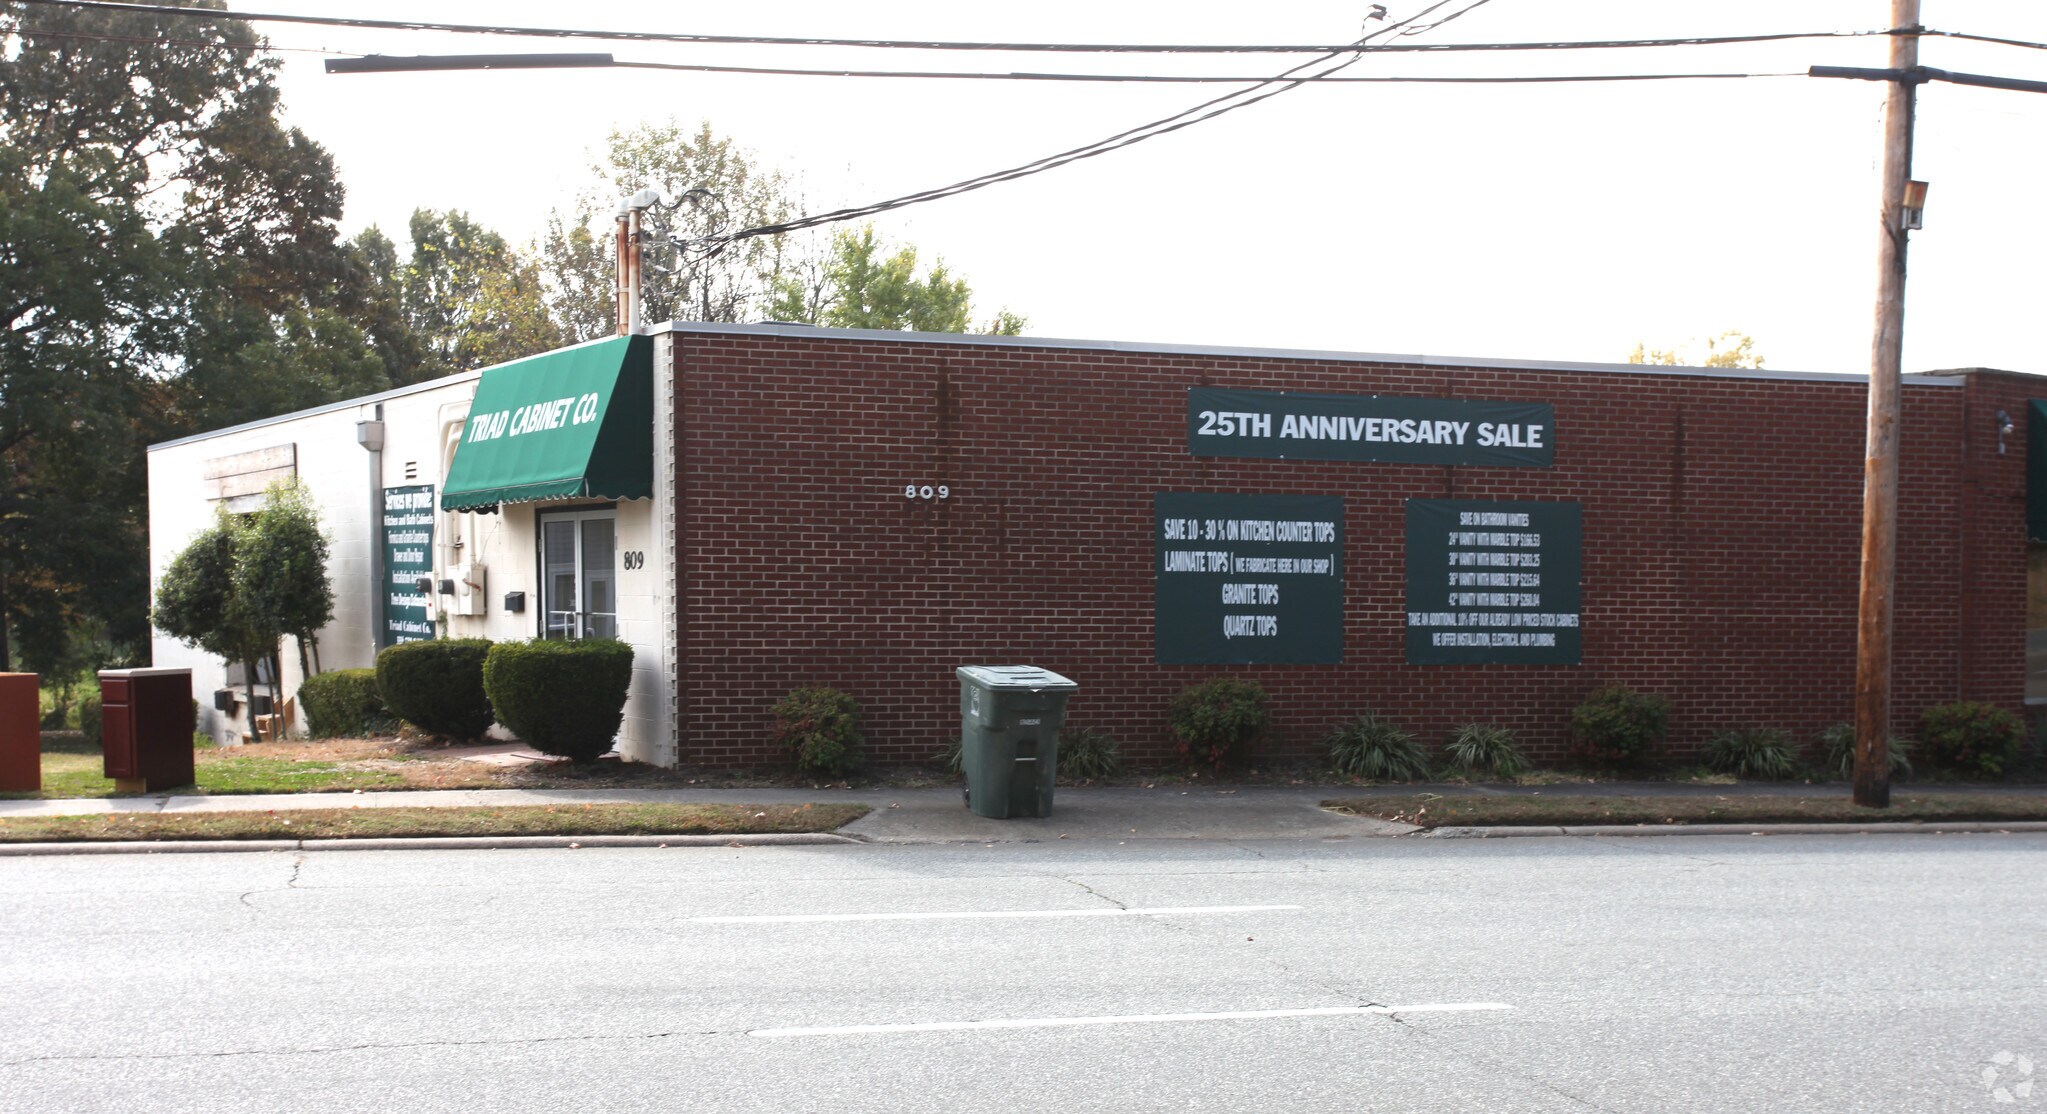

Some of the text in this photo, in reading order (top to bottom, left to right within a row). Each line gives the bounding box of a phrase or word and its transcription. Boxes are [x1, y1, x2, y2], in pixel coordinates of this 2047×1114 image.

[468, 392, 598, 443] TRIAD CABINET CO.
[1197, 410, 1544, 448] 25TH ANNIVERSARY SALE
[385, 489, 405, 510] Services
[405, 493, 412, 509] we
[905, 484, 950, 500] 809
[384, 515, 398, 526] Kitchen
[416, 513, 433, 525] Cabinets
[1460, 512, 1473, 525] SAVE
[1473, 512, 1481, 526] ON
[1481, 512, 1507, 527] BATHROOM
[1164, 519, 1186, 540] SAVE
[1187, 519, 1198, 540] 10
[1205, 519, 1216, 540] 30
[1226, 520, 1239, 541] ON
[1240, 520, 1275, 541] KITCHEN
[1276, 521, 1312, 542] COUNTER
[1314, 522, 1335, 543] TOPS
[624, 551, 644, 570] 809
[1164, 551, 1206, 572] LAMINATE
[1207, 551, 1228, 573] TOPS
[1245, 558, 1276, 573] FABRICATE
[1277, 558, 1292, 573] HERE
[1293, 559, 1300, 573] IN
[1300, 559, 1312, 573] OUR
[1222, 583, 1279, 605] GRANITE TOPS
[389, 619, 431, 634] Triad Cabinet Co.
[1223, 615, 1277, 640] QUARTZ TOPS
[1469, 613, 1478, 626] OFF
[1441, 633, 1456, 646] OFFER
